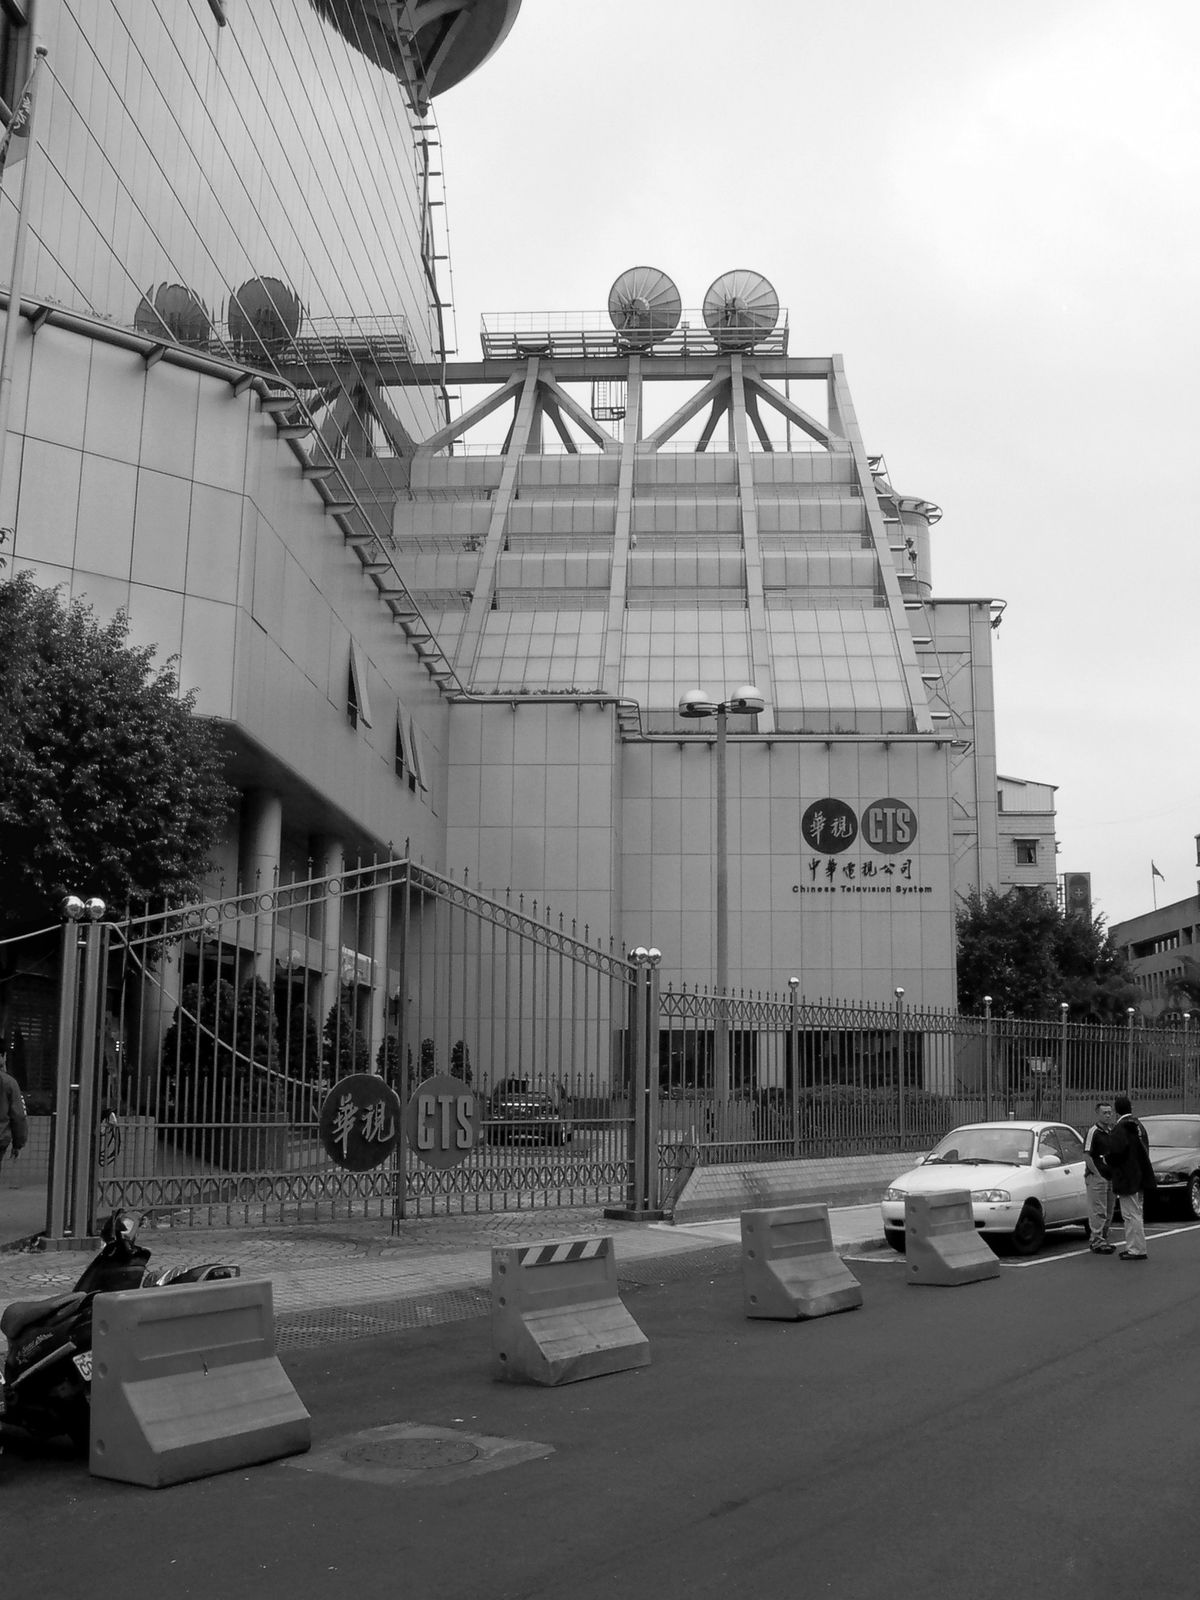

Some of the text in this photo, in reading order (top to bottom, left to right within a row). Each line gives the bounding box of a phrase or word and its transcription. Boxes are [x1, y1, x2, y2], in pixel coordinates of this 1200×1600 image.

[809, 810, 853, 845] 華視
[868, 807, 911, 844] CTS
[808, 858, 912, 883] 中華電視公司
[792, 885, 933, 895] Chinese Television System
[332, 1093, 395, 1160] 華視
[417, 1094, 474, 1150] CTS
